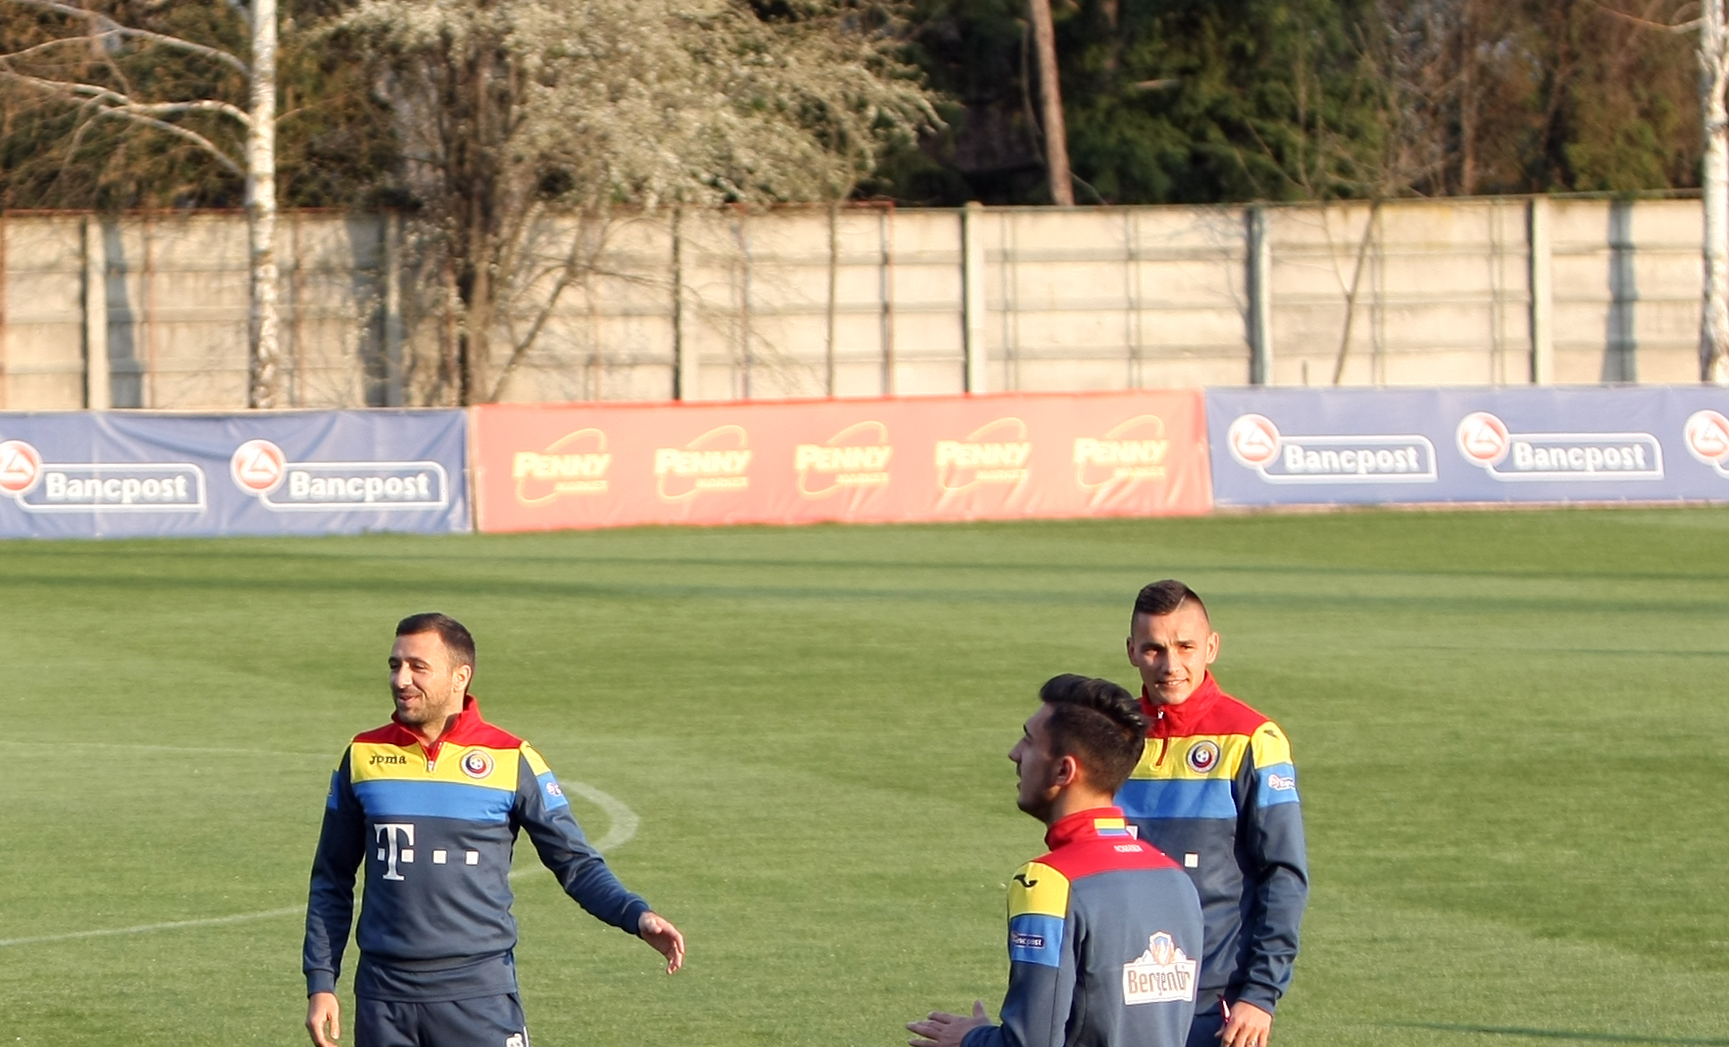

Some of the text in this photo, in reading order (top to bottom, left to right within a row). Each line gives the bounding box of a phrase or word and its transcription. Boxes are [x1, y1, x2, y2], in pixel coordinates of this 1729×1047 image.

[512, 451, 612, 479] PENNY
[654, 448, 751, 475] PENNY
[796, 444, 891, 472] PENNY
[936, 440, 1031, 468] PENNY
[1074, 438, 1168, 465] PENNY
[1284, 443, 1419, 474] Bancpost
[1513, 441, 1645, 473] Bancpost
[46, 472, 188, 503] Bancpost
[289, 471, 431, 502] Bancpost
